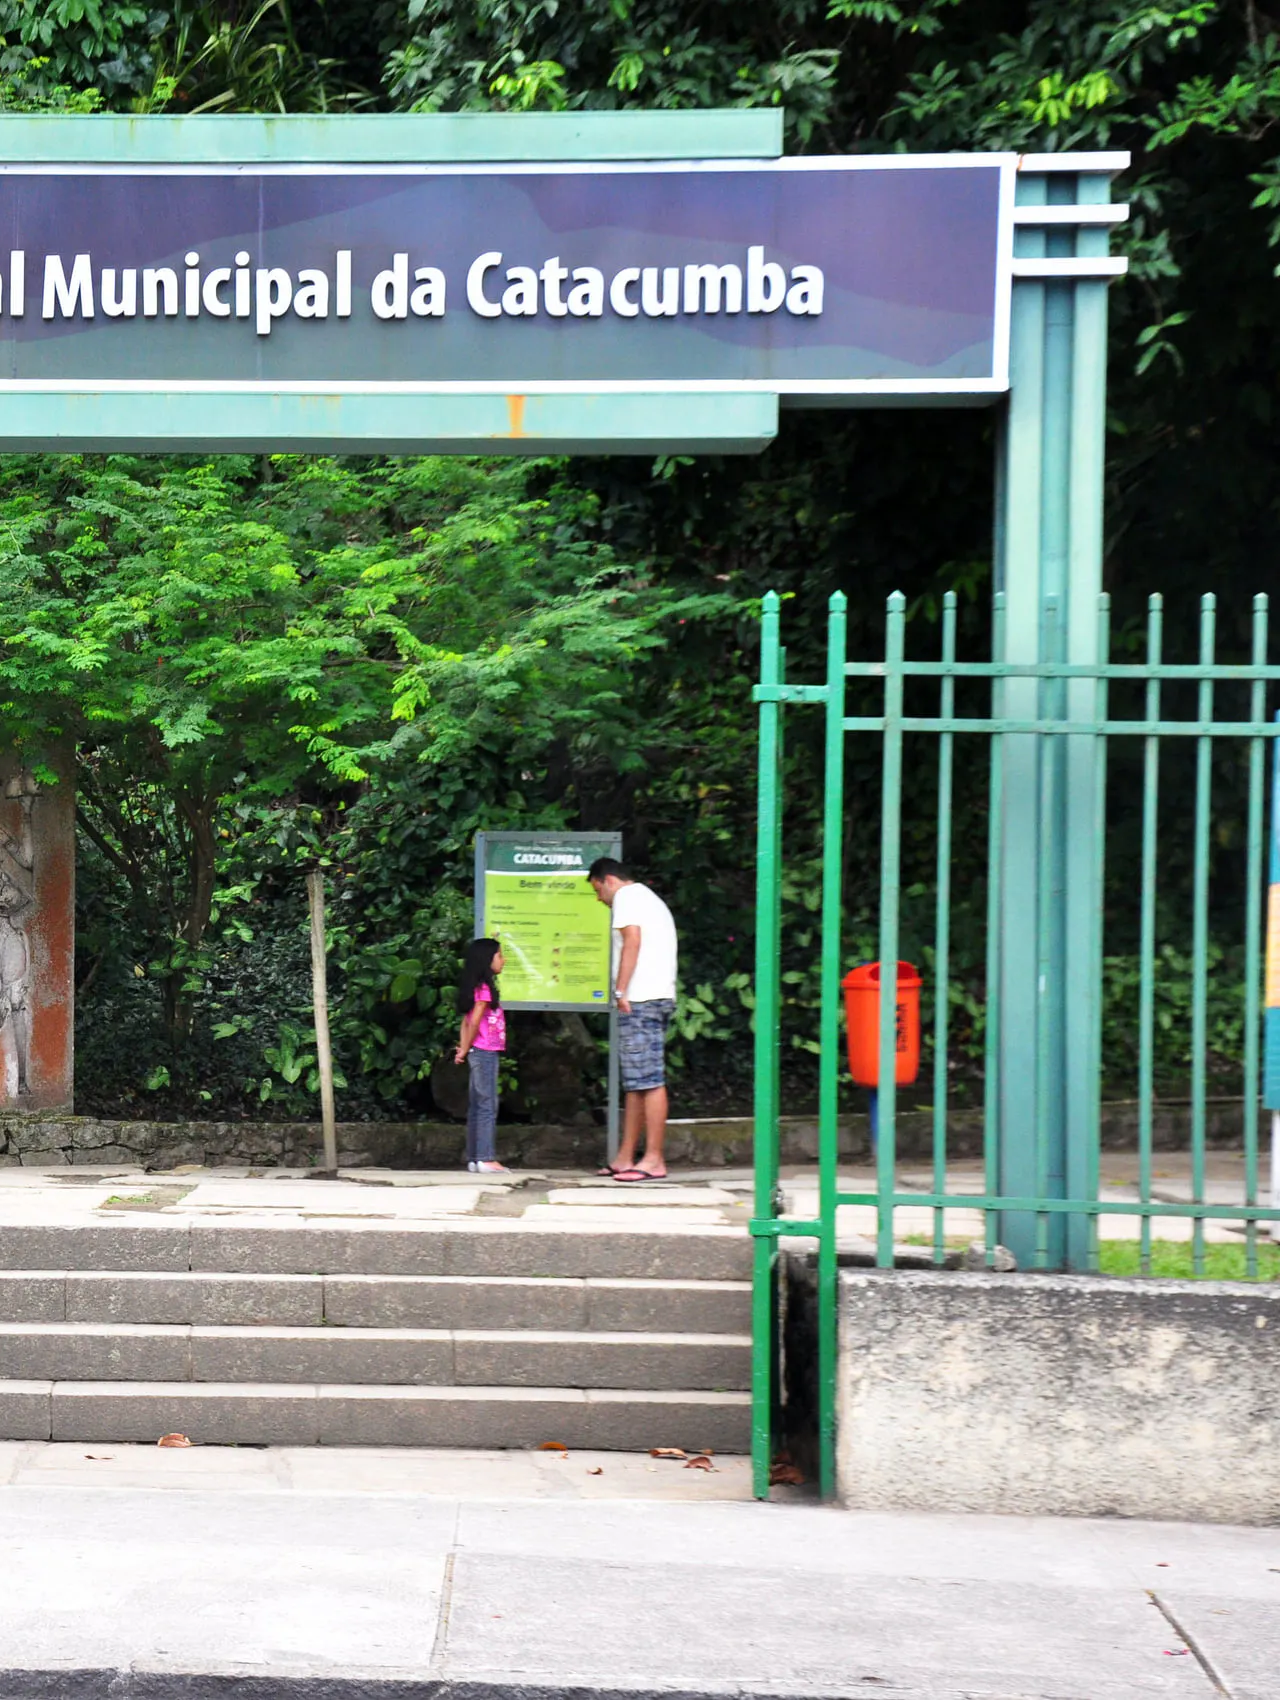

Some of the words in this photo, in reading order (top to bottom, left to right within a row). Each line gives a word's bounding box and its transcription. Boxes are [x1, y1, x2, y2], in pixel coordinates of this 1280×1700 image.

[41, 248, 352, 335] Municipal
[370, 251, 447, 319] da
[466, 244, 825, 317] Catacumba
[513, 853, 583, 865] CATACUMBA
